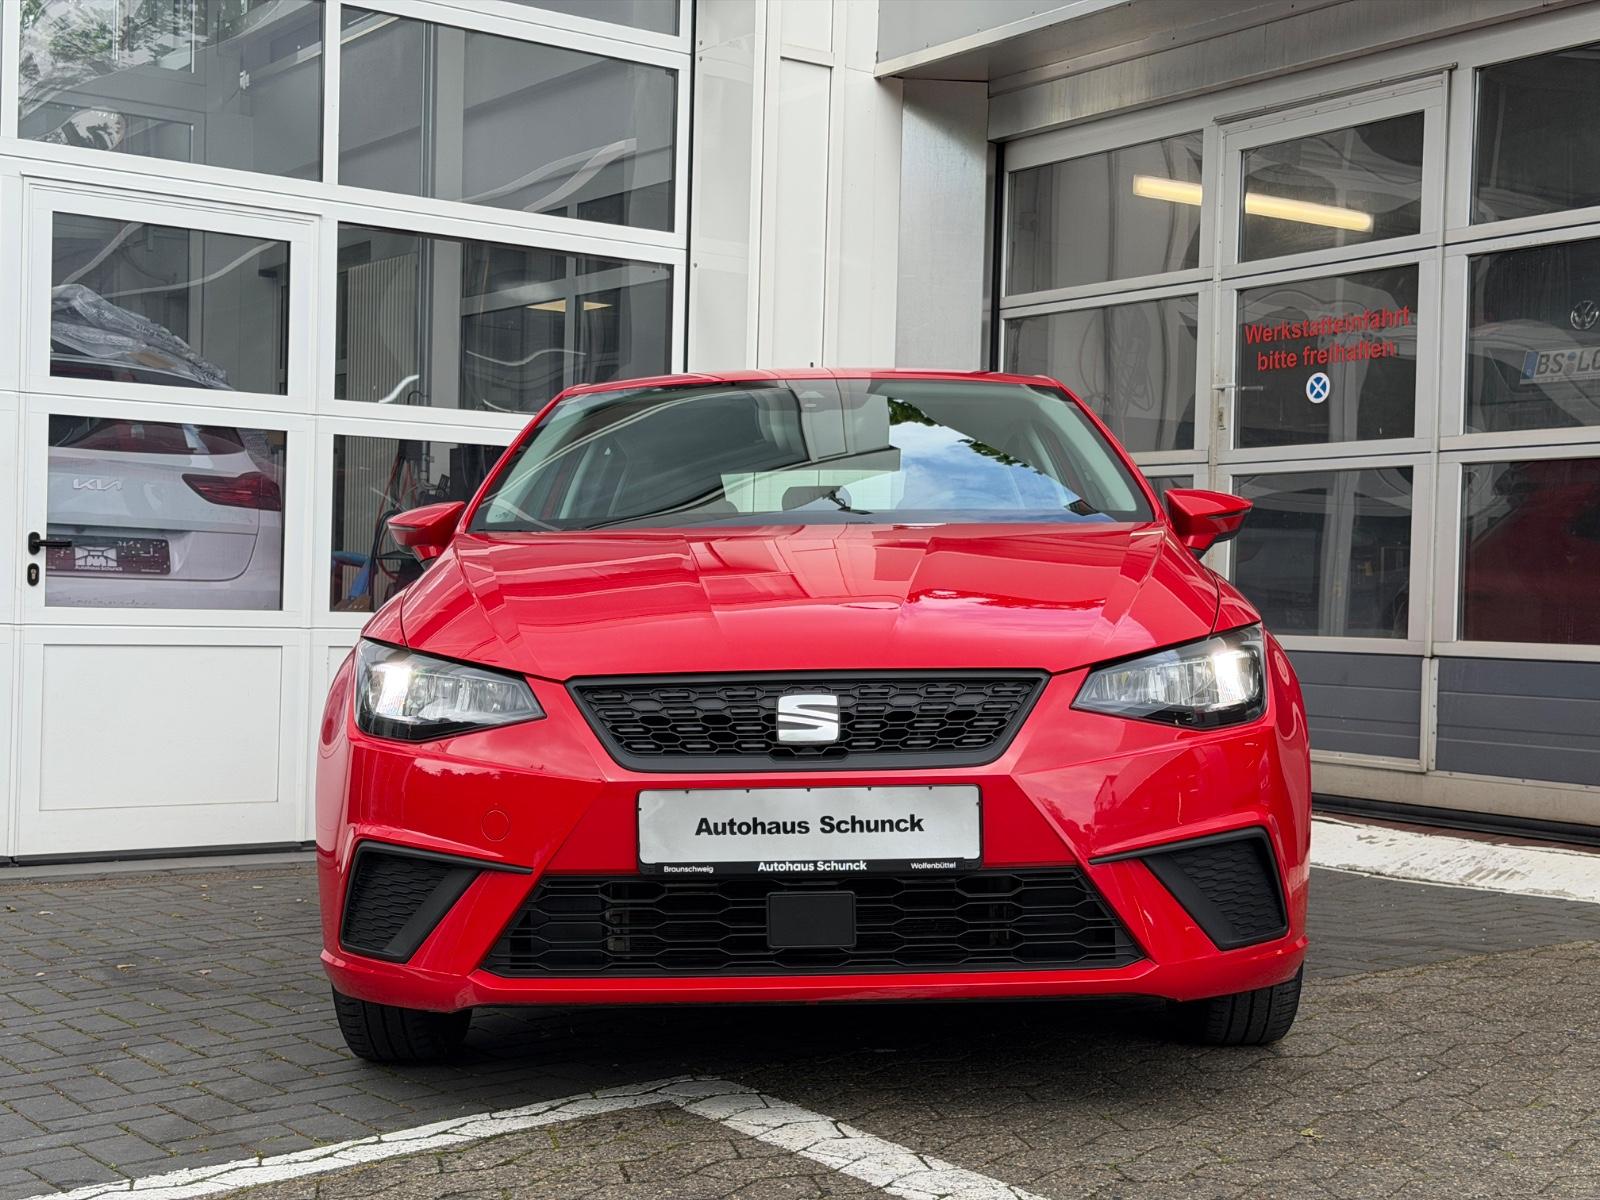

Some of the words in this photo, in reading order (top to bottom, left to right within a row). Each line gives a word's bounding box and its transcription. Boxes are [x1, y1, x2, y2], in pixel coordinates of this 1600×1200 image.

[1244, 305, 1410, 344] Werkstatteinfahrt
[1256, 350, 1297, 371] bitte
[1303, 340, 1396, 365] freihalten
[1536, 352, 1565, 375] BS
[73, 479, 122, 490] KIA
[695, 816, 810, 835] Autohaus
[819, 814, 924, 834] Schunck
[757, 861, 815, 872] Autohaus
[817, 860, 867, 872] Schunck
[911, 861, 956, 869] Wolfenbüttel
